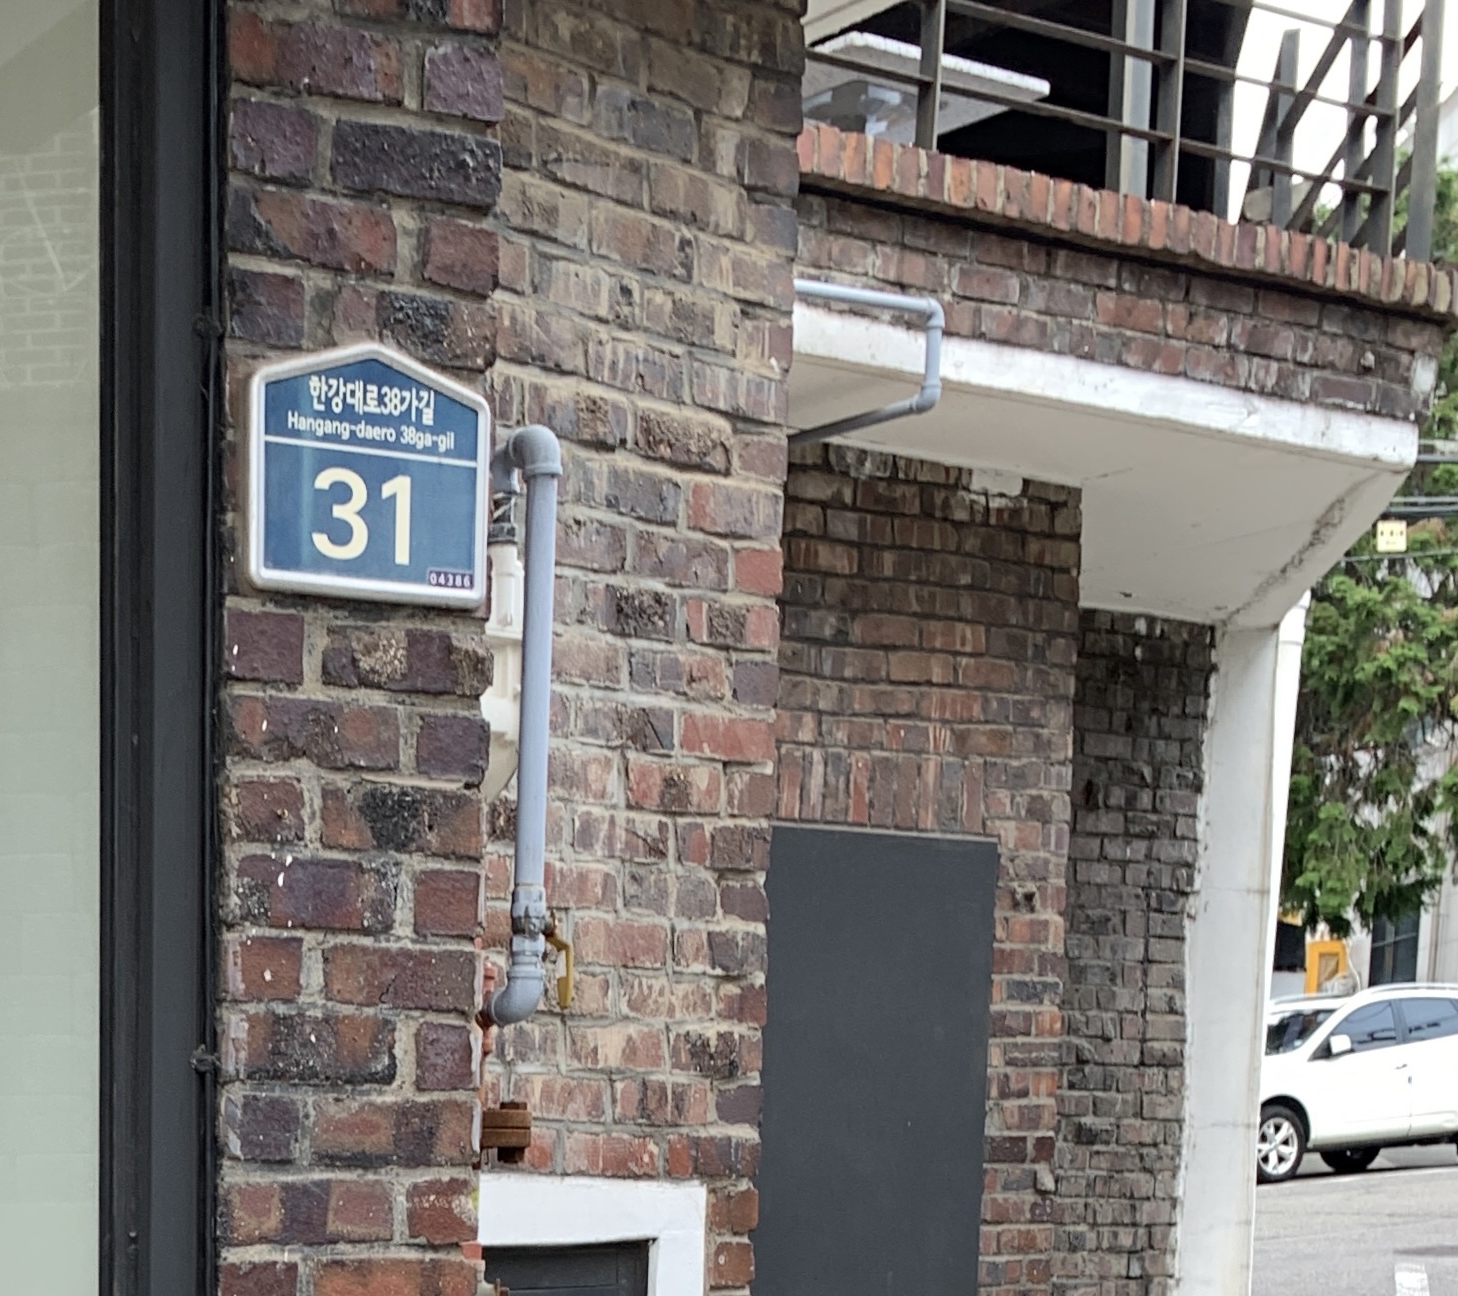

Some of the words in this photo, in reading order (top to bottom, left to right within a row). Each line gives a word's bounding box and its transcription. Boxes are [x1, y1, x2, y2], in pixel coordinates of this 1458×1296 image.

[308, 375, 435, 426] 한강대로38가길
[287, 410, 396, 441] Hangang-daero
[400, 425, 455, 452] 38ga-gil
[311, 467, 412, 566] 31
[429, 573, 471, 588] 04386
